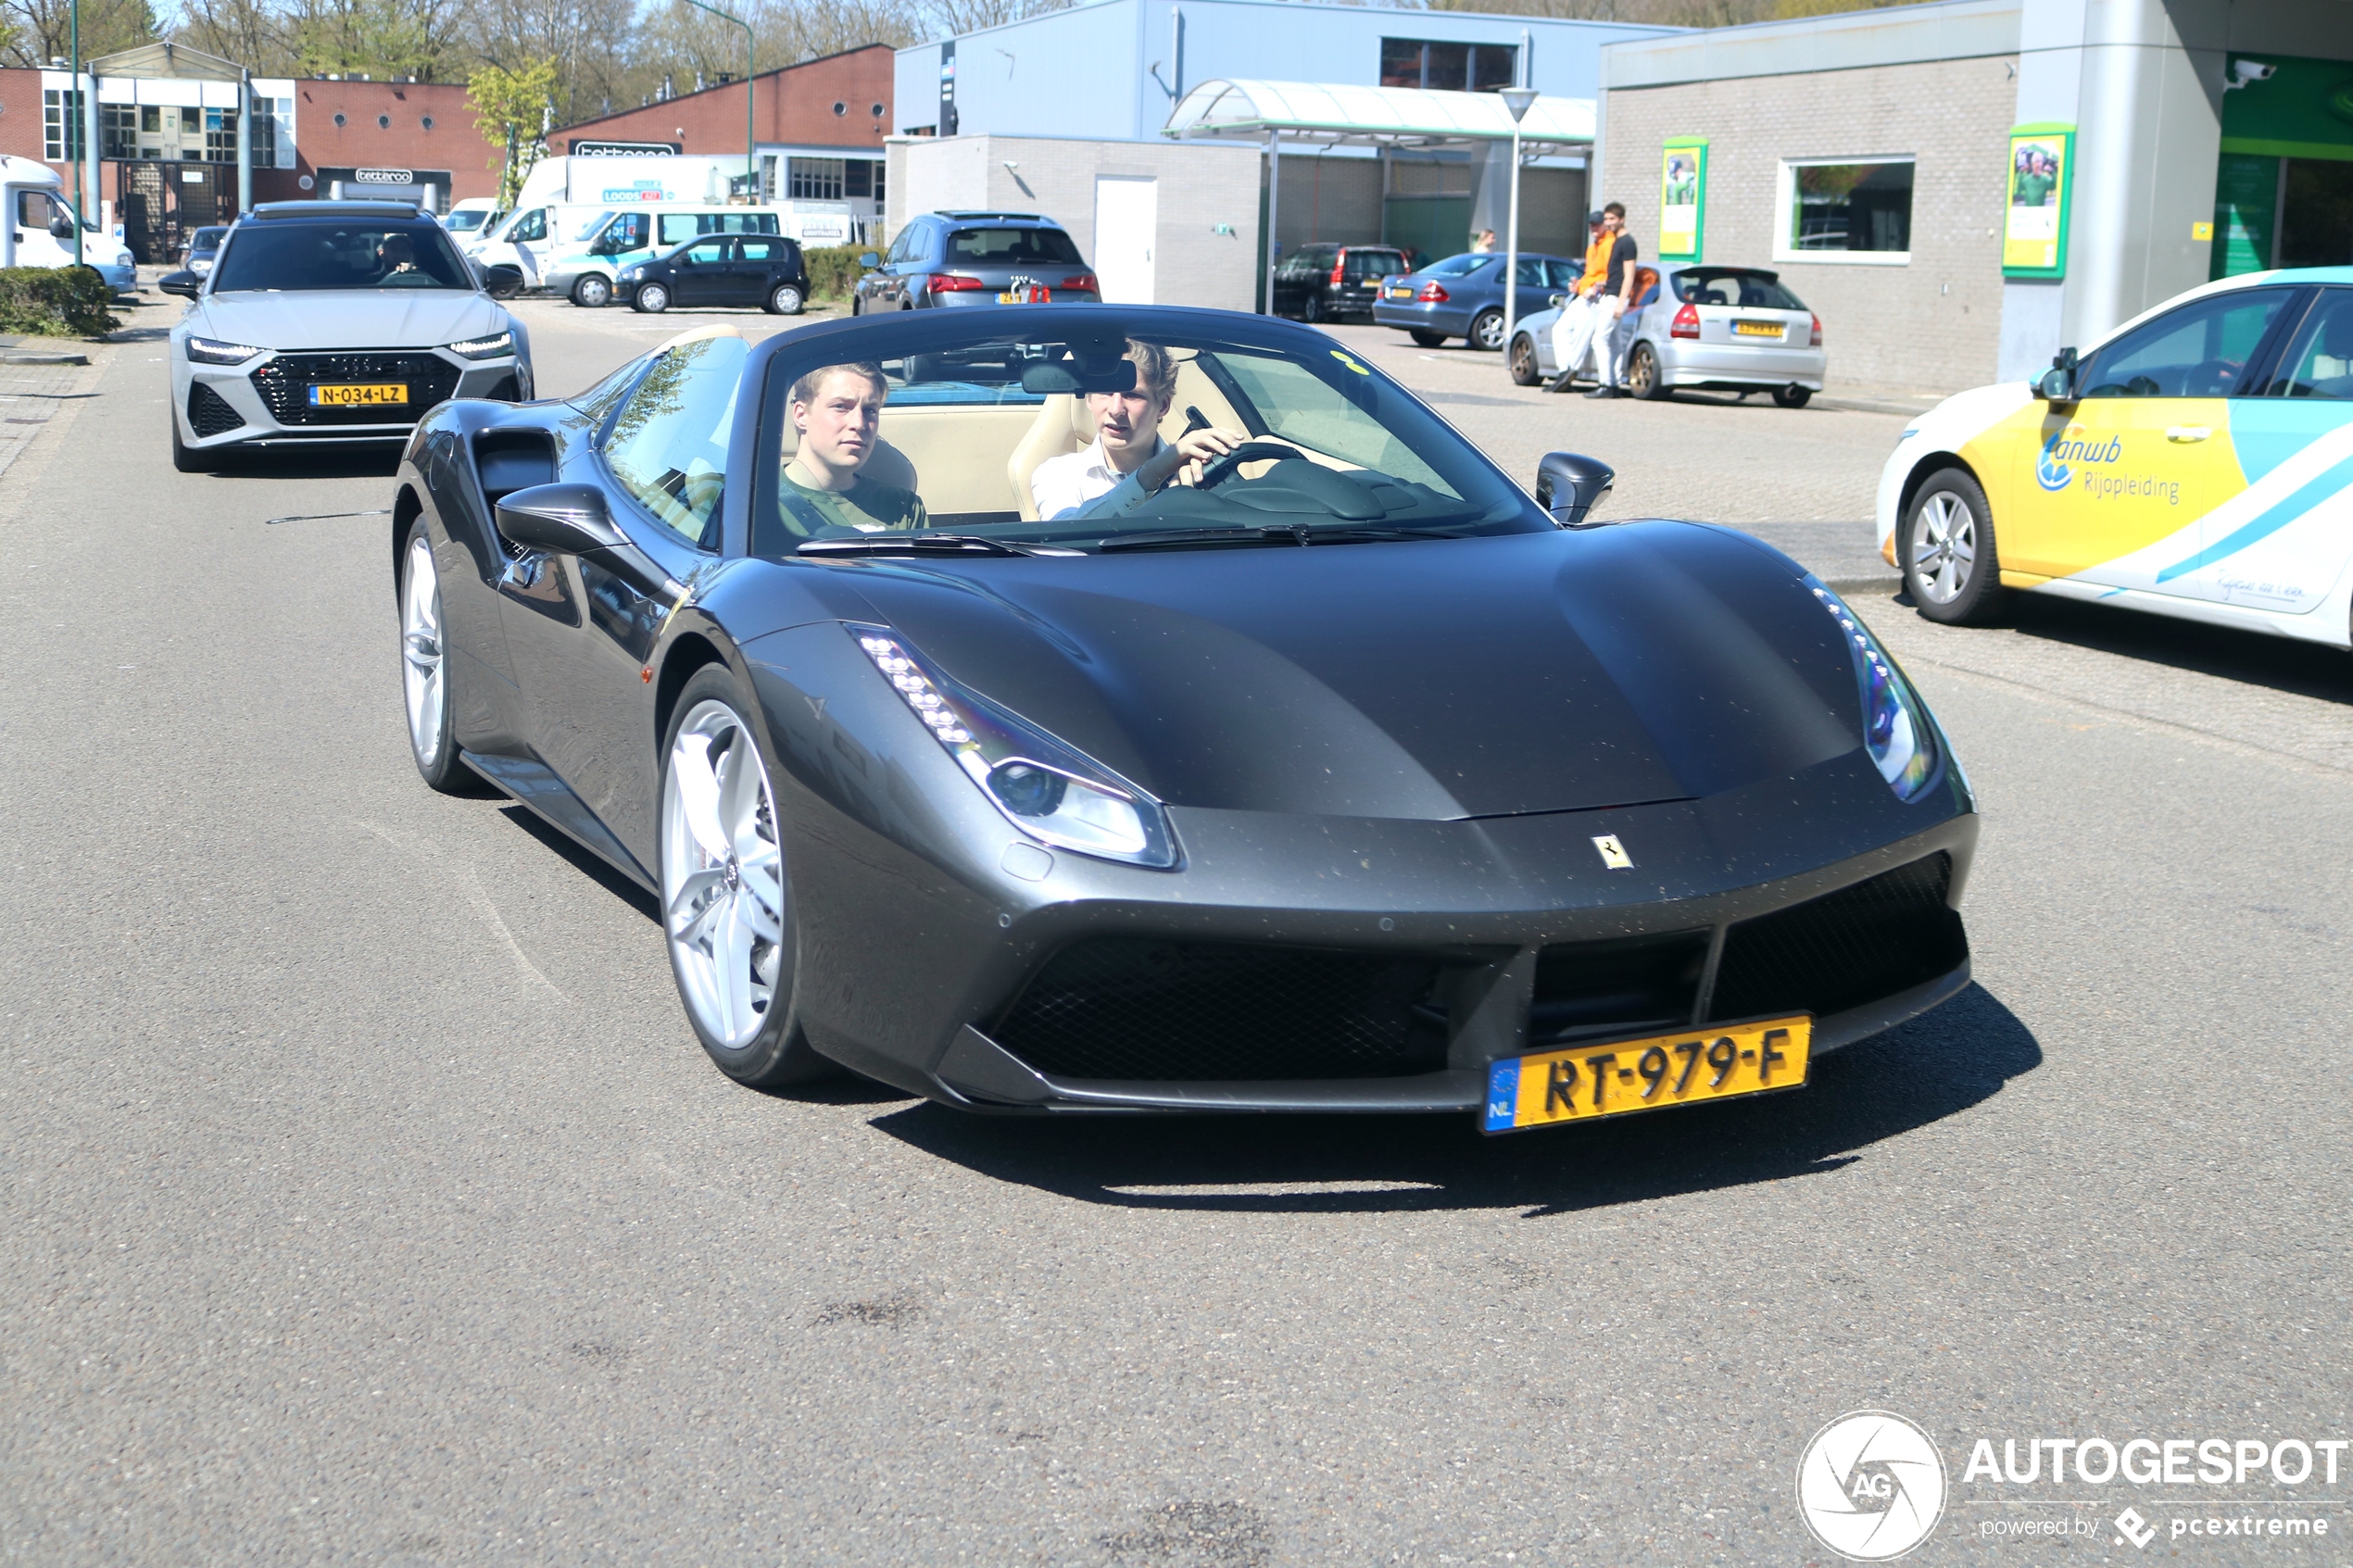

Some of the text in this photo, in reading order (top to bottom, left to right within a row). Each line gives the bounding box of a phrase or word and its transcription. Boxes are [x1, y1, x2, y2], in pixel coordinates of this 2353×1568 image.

[359, 171, 409, 182] tetteroo
[604, 191, 640, 201] LOODS
[323, 387, 399, 403] N-034-LZ
[2055, 434, 2121, 463] anwb
[2084, 471, 2179, 505] Rijopleiding
[1545, 1028, 1788, 1112] RT-979-F
[1489, 1102, 1512, 1118] NL
